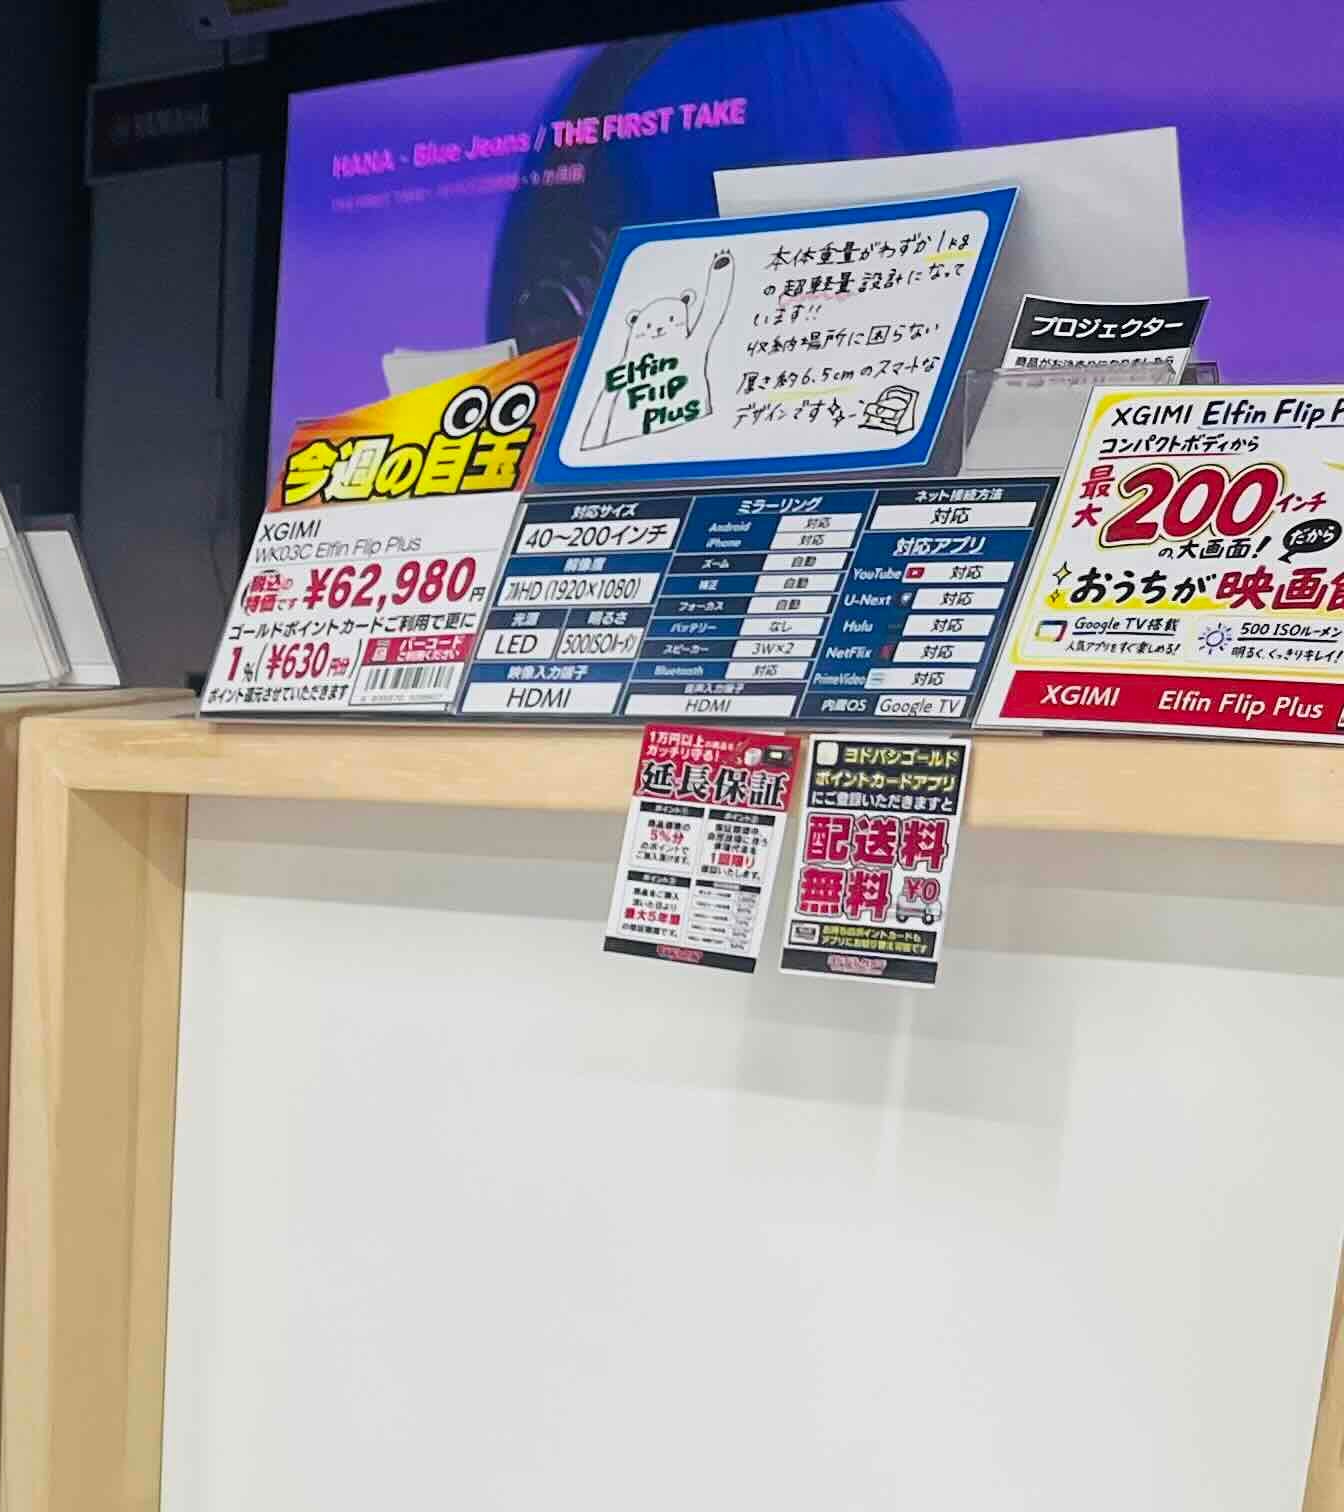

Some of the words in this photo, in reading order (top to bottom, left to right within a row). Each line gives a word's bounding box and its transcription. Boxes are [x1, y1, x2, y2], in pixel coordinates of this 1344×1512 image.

[332, 149, 395, 177] HANA
[413, 140, 462, 168] Blue
[465, 130, 530, 162] Jeans
[551, 119, 598, 149] THE
[603, 107, 673, 141] FIRST
[678, 97, 748, 131] TAKE
[1031, 316, 1184, 339] プロジェクター
[605, 352, 680, 393] Elfin
[1111, 404, 1193, 428] XGIMI
[1202, 399, 1267, 425] Elfin
[1273, 398, 1325, 429] Flip
[1099, 434, 1260, 455] コンパクトボディから
[282, 427, 534, 505] 今週の目玉
[737, 496, 824, 515] ミラーリング
[1072, 464, 1116, 529] 最大
[1099, 462, 1285, 548] 200
[1275, 491, 1328, 513] インチ
[570, 503, 638, 520] 対応サイズ
[929, 506, 972, 526] 対応
[258, 519, 322, 543] XGIMI
[1288, 524, 1337, 547] だから
[315, 540, 349, 560] Elfin
[353, 537, 386, 558] Flip
[387, 535, 423, 553] Plus
[893, 536, 986, 557] 対応アプリ
[1157, 535, 1273, 561] の大画面!
[791, 555, 818, 570] 自動
[949, 564, 983, 581] 対応
[783, 576, 810, 592] 自動
[853, 567, 904, 582] YouTube
[677, 600, 725, 613] フォーカス
[844, 592, 892, 607] U-Next
[940, 591, 974, 607] 対応
[228, 611, 479, 641] ゴールドポイントカードご利用で更に
[768, 620, 793, 634] なし
[842, 620, 874, 634] Hulu
[931, 617, 964, 633] 対応
[1073, 617, 1120, 634] Google
[1124, 617, 1180, 633] TV搭載
[1239, 622, 1269, 636] 500
[1272, 623, 1343, 639] ISOルーメン
[399, 635, 465, 653] バーコード
[494, 634, 539, 655] LED
[920, 644, 956, 661] 対応
[911, 670, 946, 687] 対応
[505, 687, 572, 709] HDMI
[685, 699, 733, 714] HDMI
[879, 698, 934, 717] Google
[937, 698, 961, 714] TV
[1040, 684, 1121, 707] XGIMI
[1157, 689, 1212, 713] Elfin
[1218, 692, 1266, 721] Flip
[1272, 696, 1325, 720] Plus
[843, 746, 961, 768] ヨドバシゴールド
[640, 759, 789, 809] 延長保証
[814, 771, 956, 792] ポイントカードアプリ
[804, 812, 950, 873] 配送料
[796, 865, 893, 922] 無料
